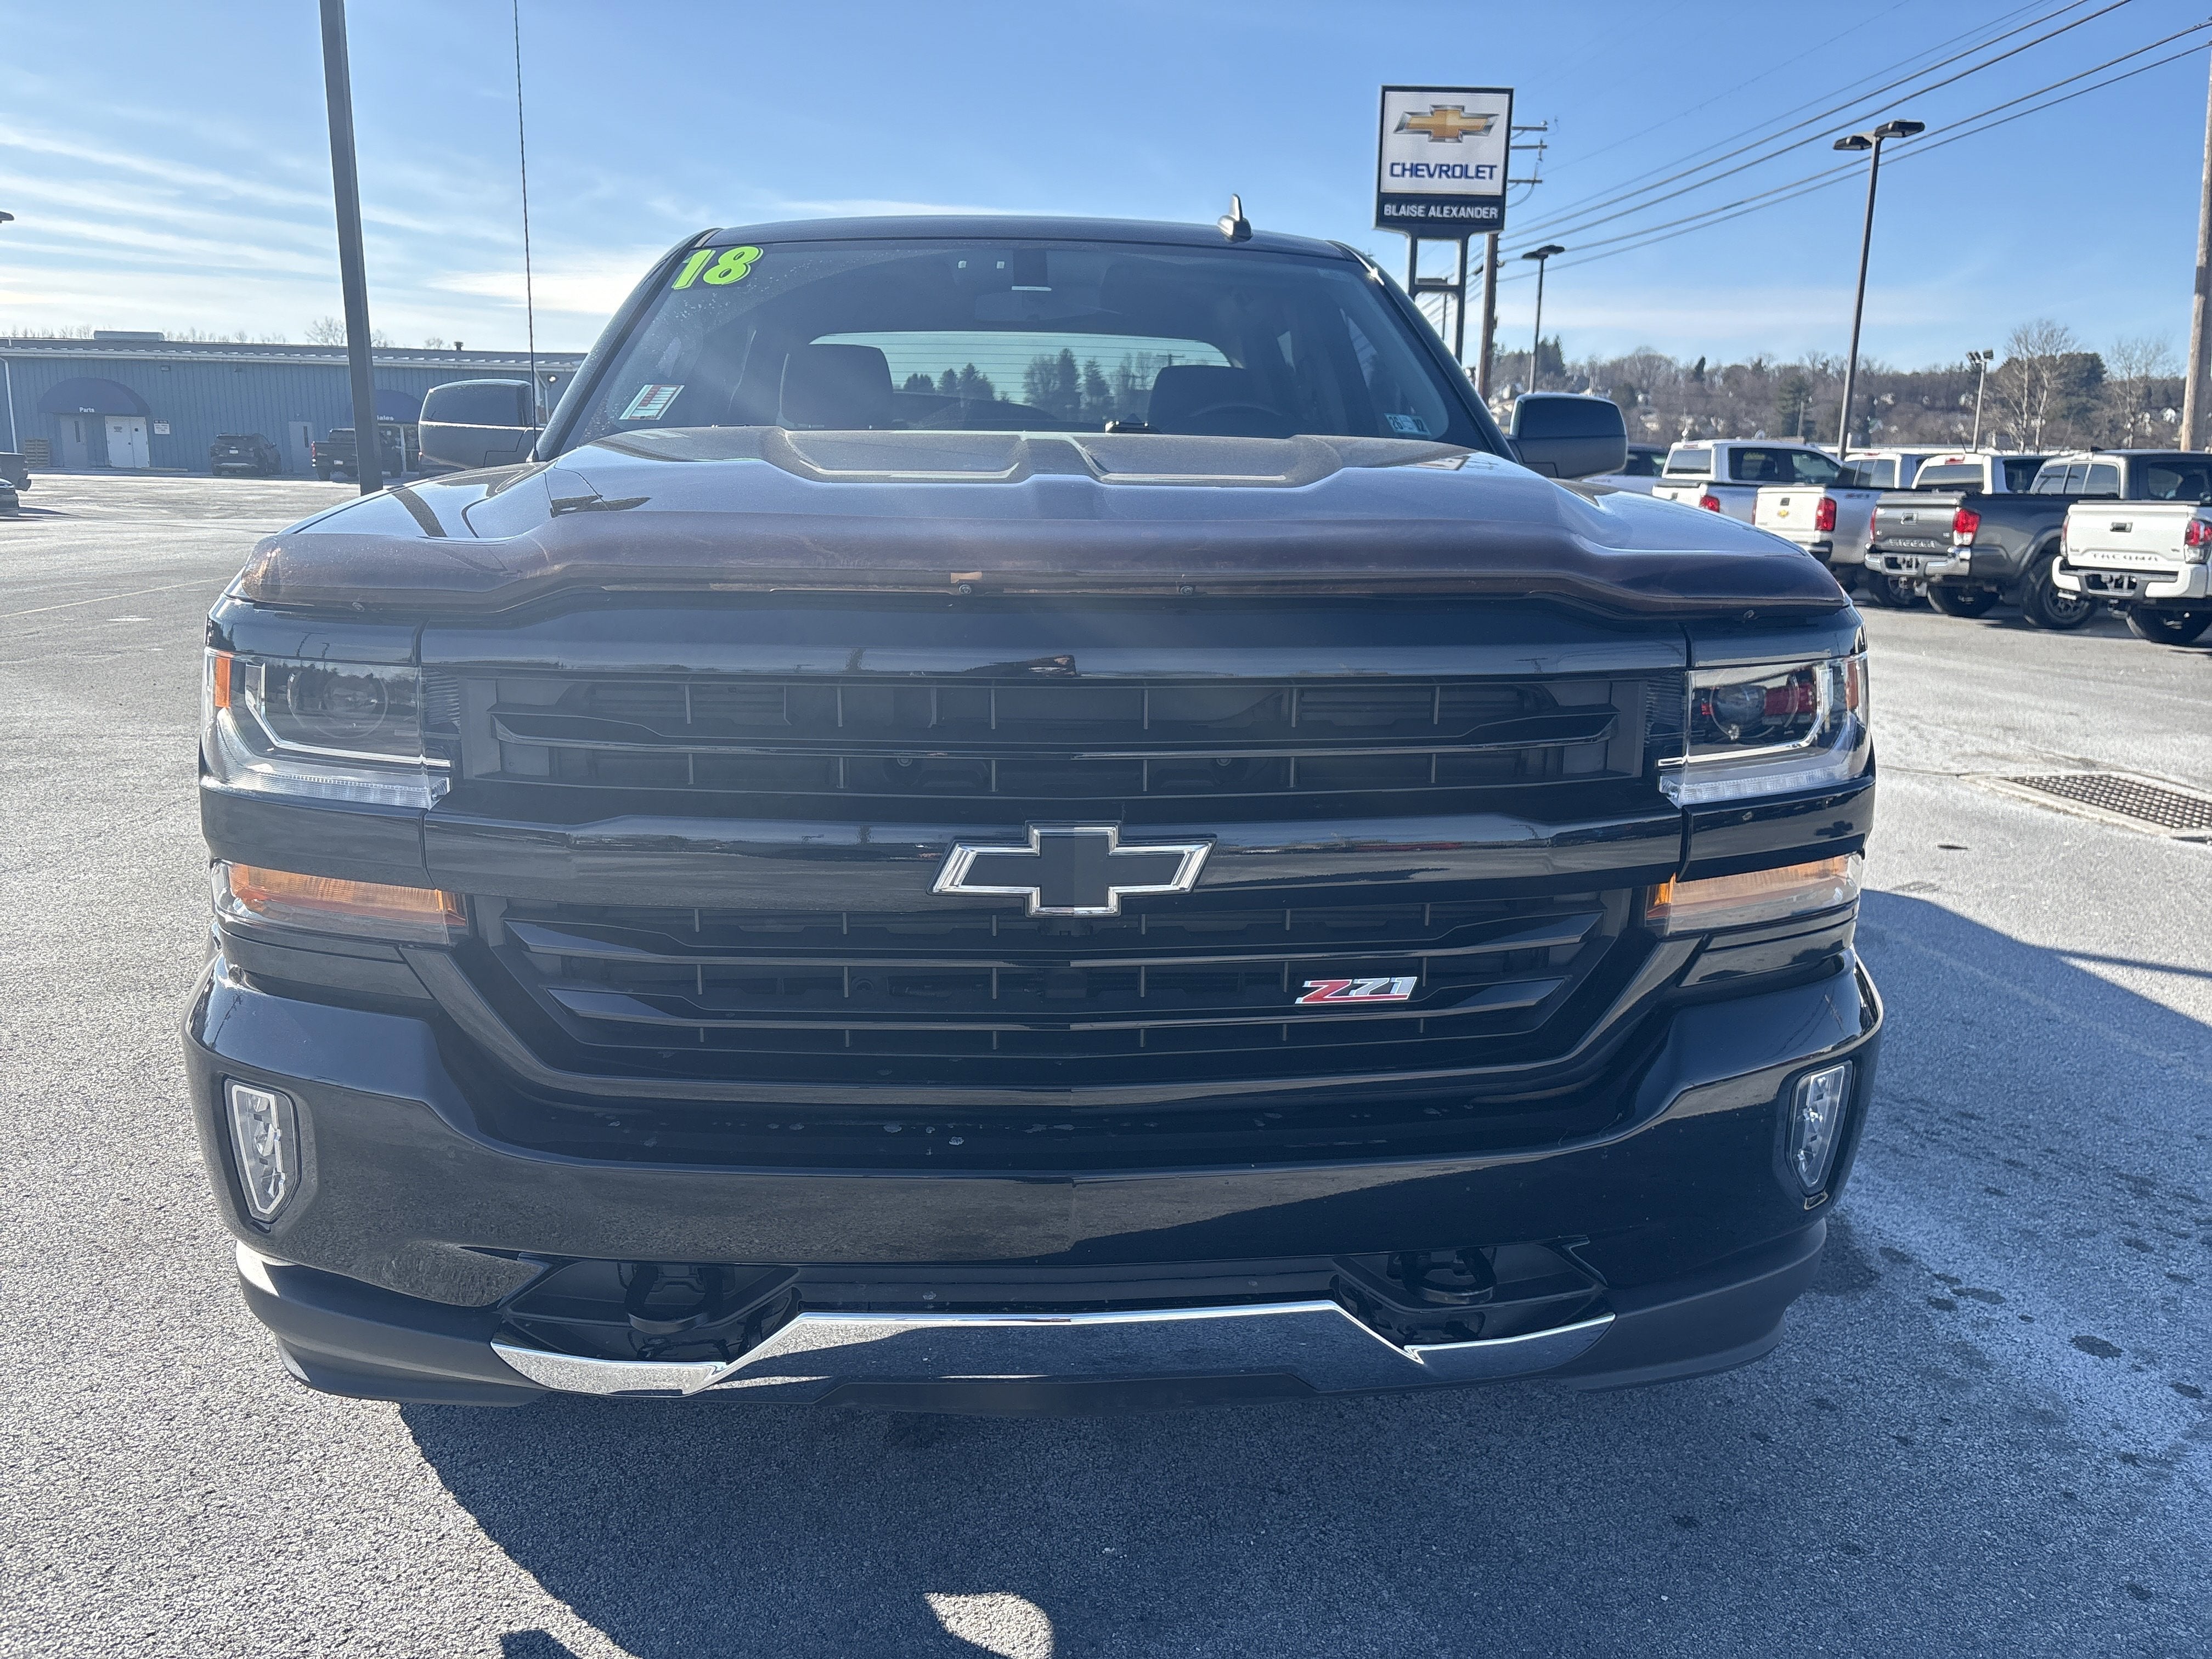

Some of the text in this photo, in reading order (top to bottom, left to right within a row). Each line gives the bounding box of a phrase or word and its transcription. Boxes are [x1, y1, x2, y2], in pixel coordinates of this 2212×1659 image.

[1389, 162, 1497, 180] CHEVROLET
[1384, 203, 1499, 219] BLAISE ALEXANDER
[671, 246, 764, 290] 18
[1294, 976, 1418, 1005] Z71
